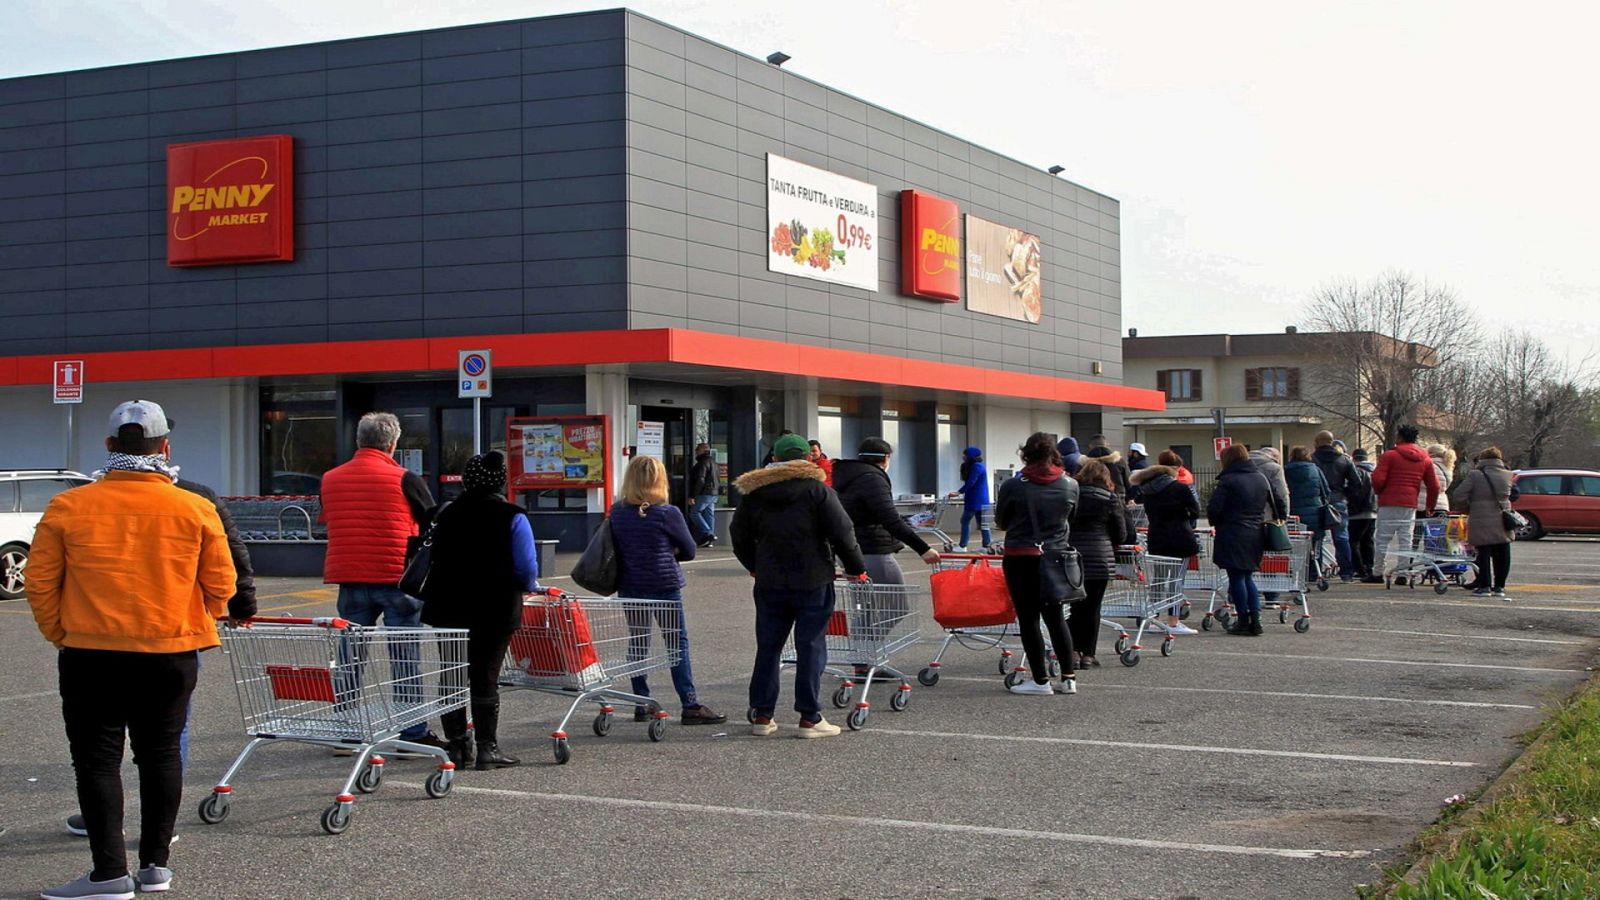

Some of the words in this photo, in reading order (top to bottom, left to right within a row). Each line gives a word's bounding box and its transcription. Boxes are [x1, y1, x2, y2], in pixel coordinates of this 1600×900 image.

[171, 184, 275, 213] PENNY
[770, 178, 796, 197] TANTA
[798, 186, 828, 206] FRUTTA
[829, 198, 834, 208] e
[835, 197, 869, 216] VERDURA
[208, 212, 268, 227] MARKET
[838, 214, 872, 250] 0,99€
[921, 228, 960, 257] PENN
